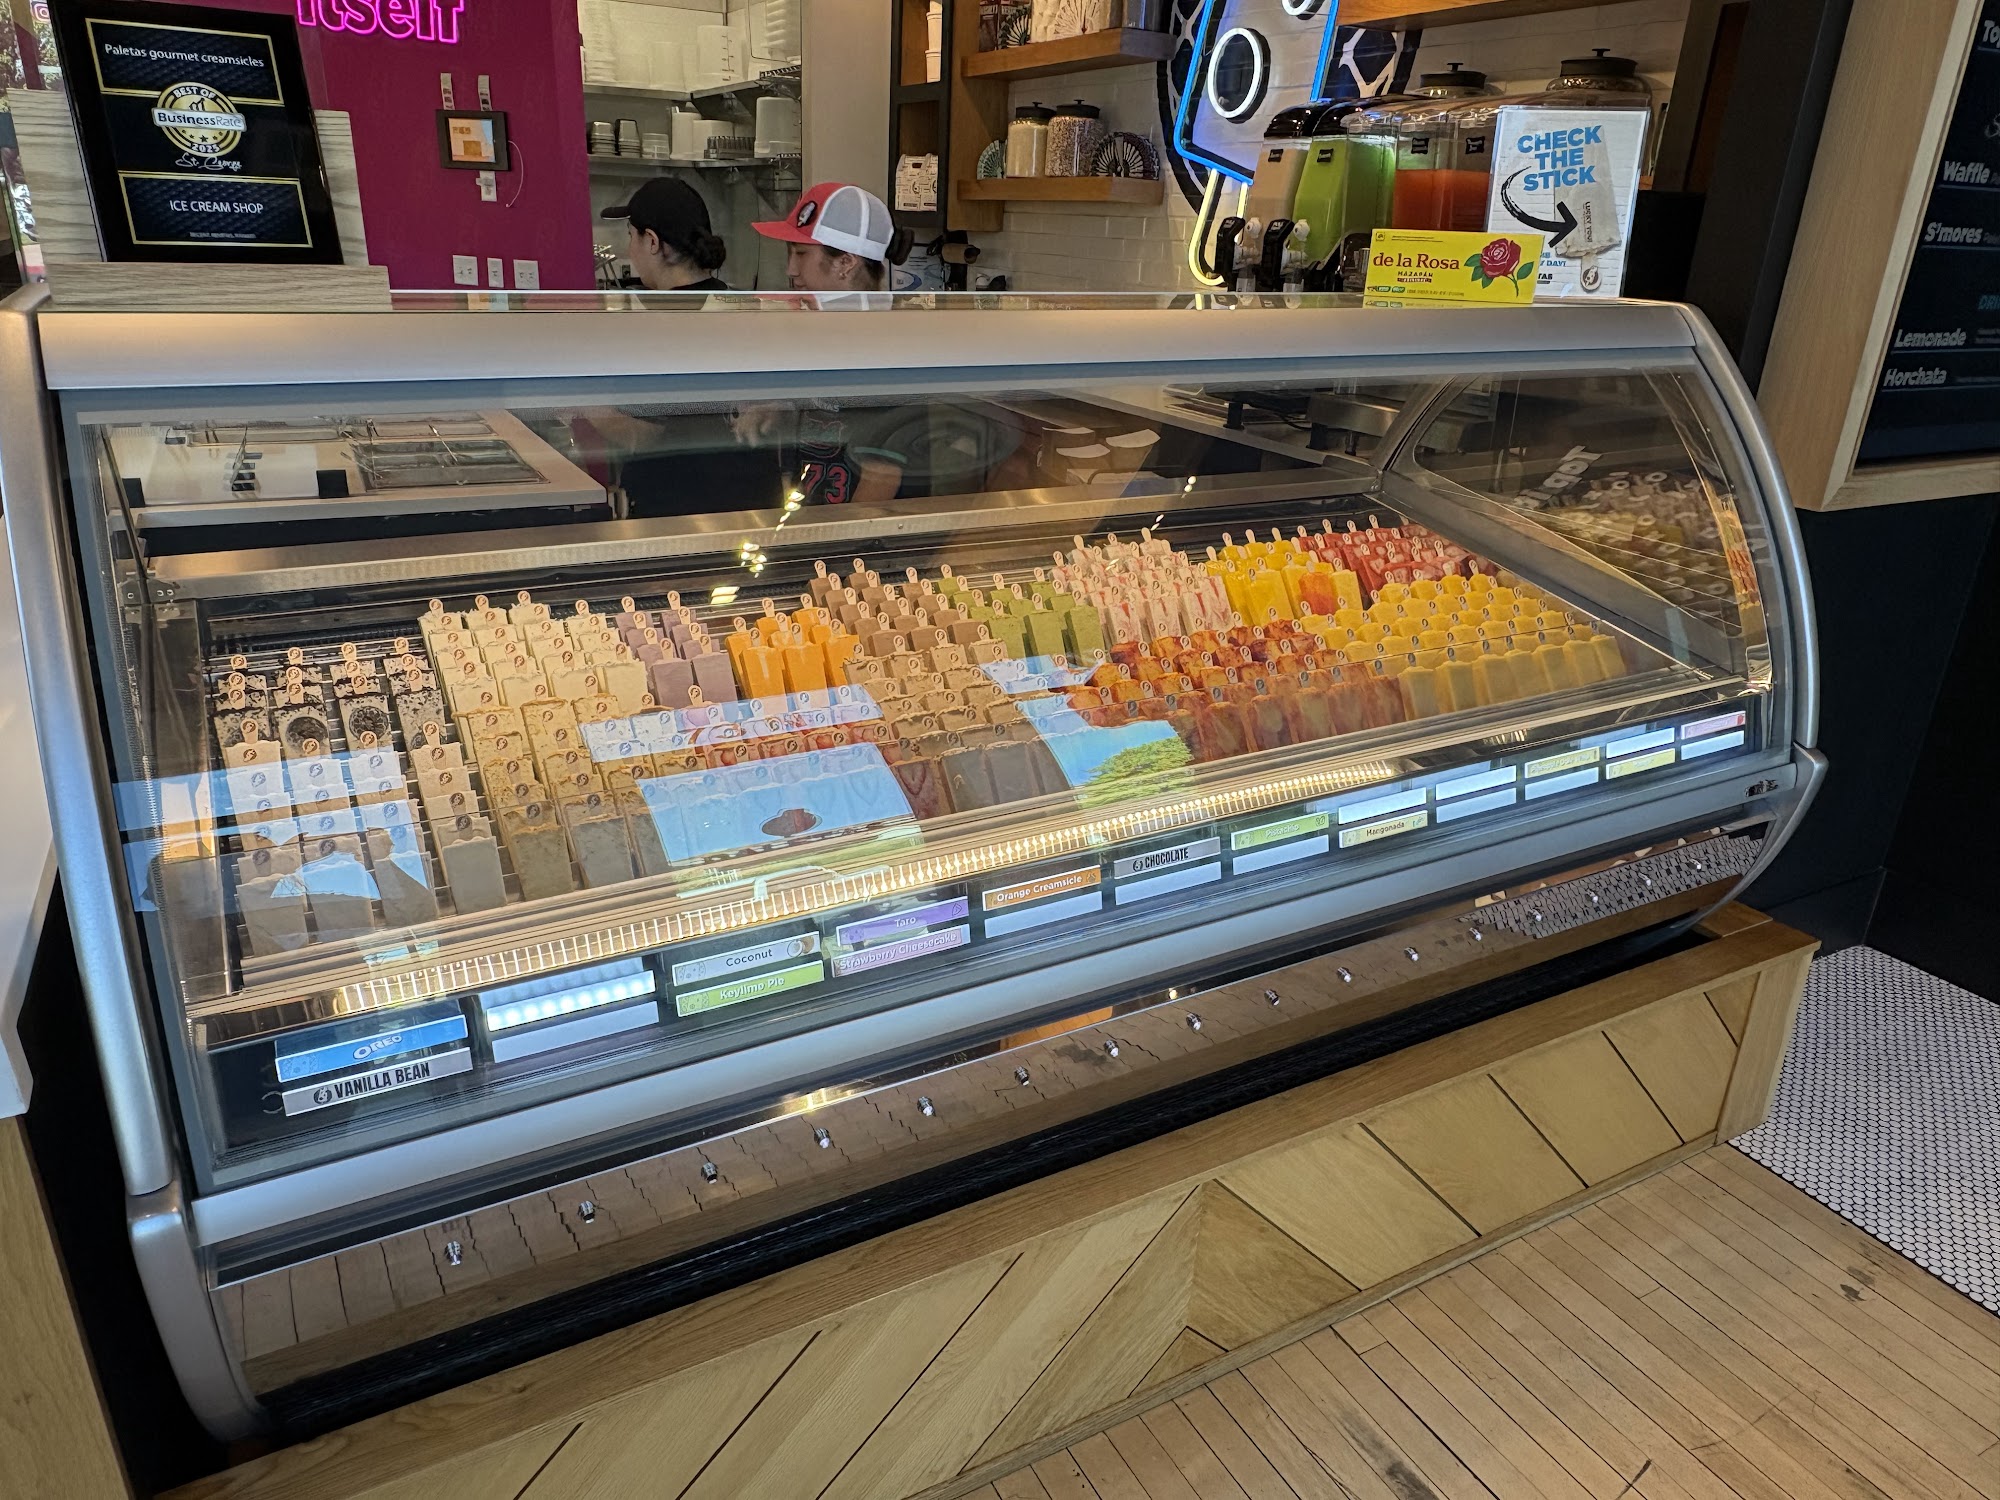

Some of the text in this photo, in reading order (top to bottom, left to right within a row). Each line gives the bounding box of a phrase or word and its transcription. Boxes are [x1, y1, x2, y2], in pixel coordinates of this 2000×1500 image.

[105, 43, 265, 67] Paletas gourmet creamsicles
[173, 86, 216, 99] BEST OF
[157, 111, 243, 128] BusinessRate
[191, 144, 220, 153] 2025
[1517, 125, 1602, 154] CHECK
[1534, 148, 1585, 171] THE
[1523, 165, 1596, 192] STICK
[1943, 161, 1990, 184] Waffle
[169, 200, 264, 214] ICE CREAM SHOP
[1373, 252, 1460, 270] de la Rosa
[1894, 328, 1967, 348] Lemonade
[1883, 367, 1947, 387] Horchata
[1145, 848, 1189, 868] CHOCOLATE
[997, 874, 1083, 902] Orange Creamsicle
[894, 916, 916, 928] Taro
[725, 949, 773, 967] Coconut
[839, 931, 957, 970] Strawberry Cheesecake
[720, 977, 785, 1000] Keylime Pie
[352, 1035, 403, 1060] OREO
[334, 1062, 431, 1099] VANILLA BEAN
